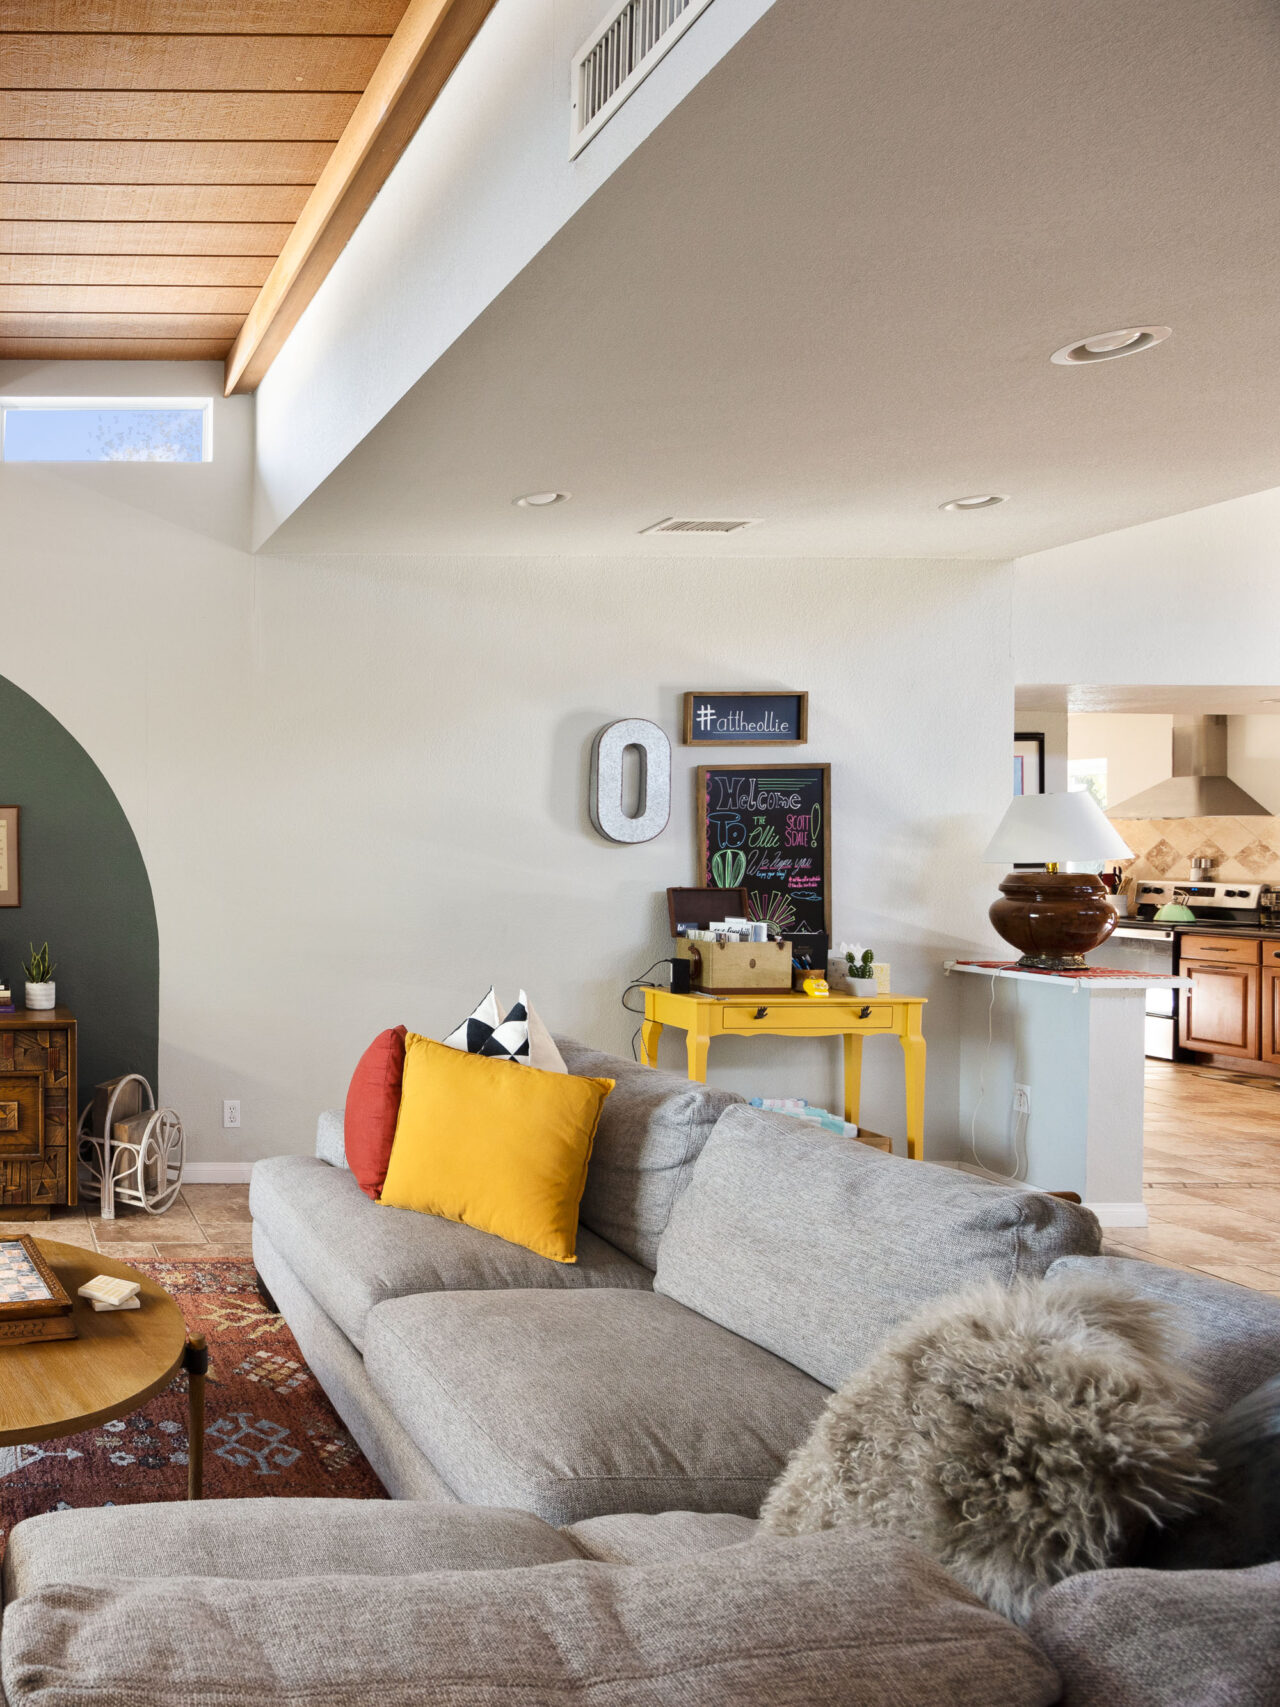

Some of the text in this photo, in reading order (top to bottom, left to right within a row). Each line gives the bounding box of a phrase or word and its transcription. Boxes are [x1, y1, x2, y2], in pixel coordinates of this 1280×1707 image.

[696, 704, 789, 732] #attheollie
[714, 776, 802, 811] Welcome
[748, 825, 780, 848] Ollie
[747, 849, 770, 876] We
[792, 857, 813, 876] you
